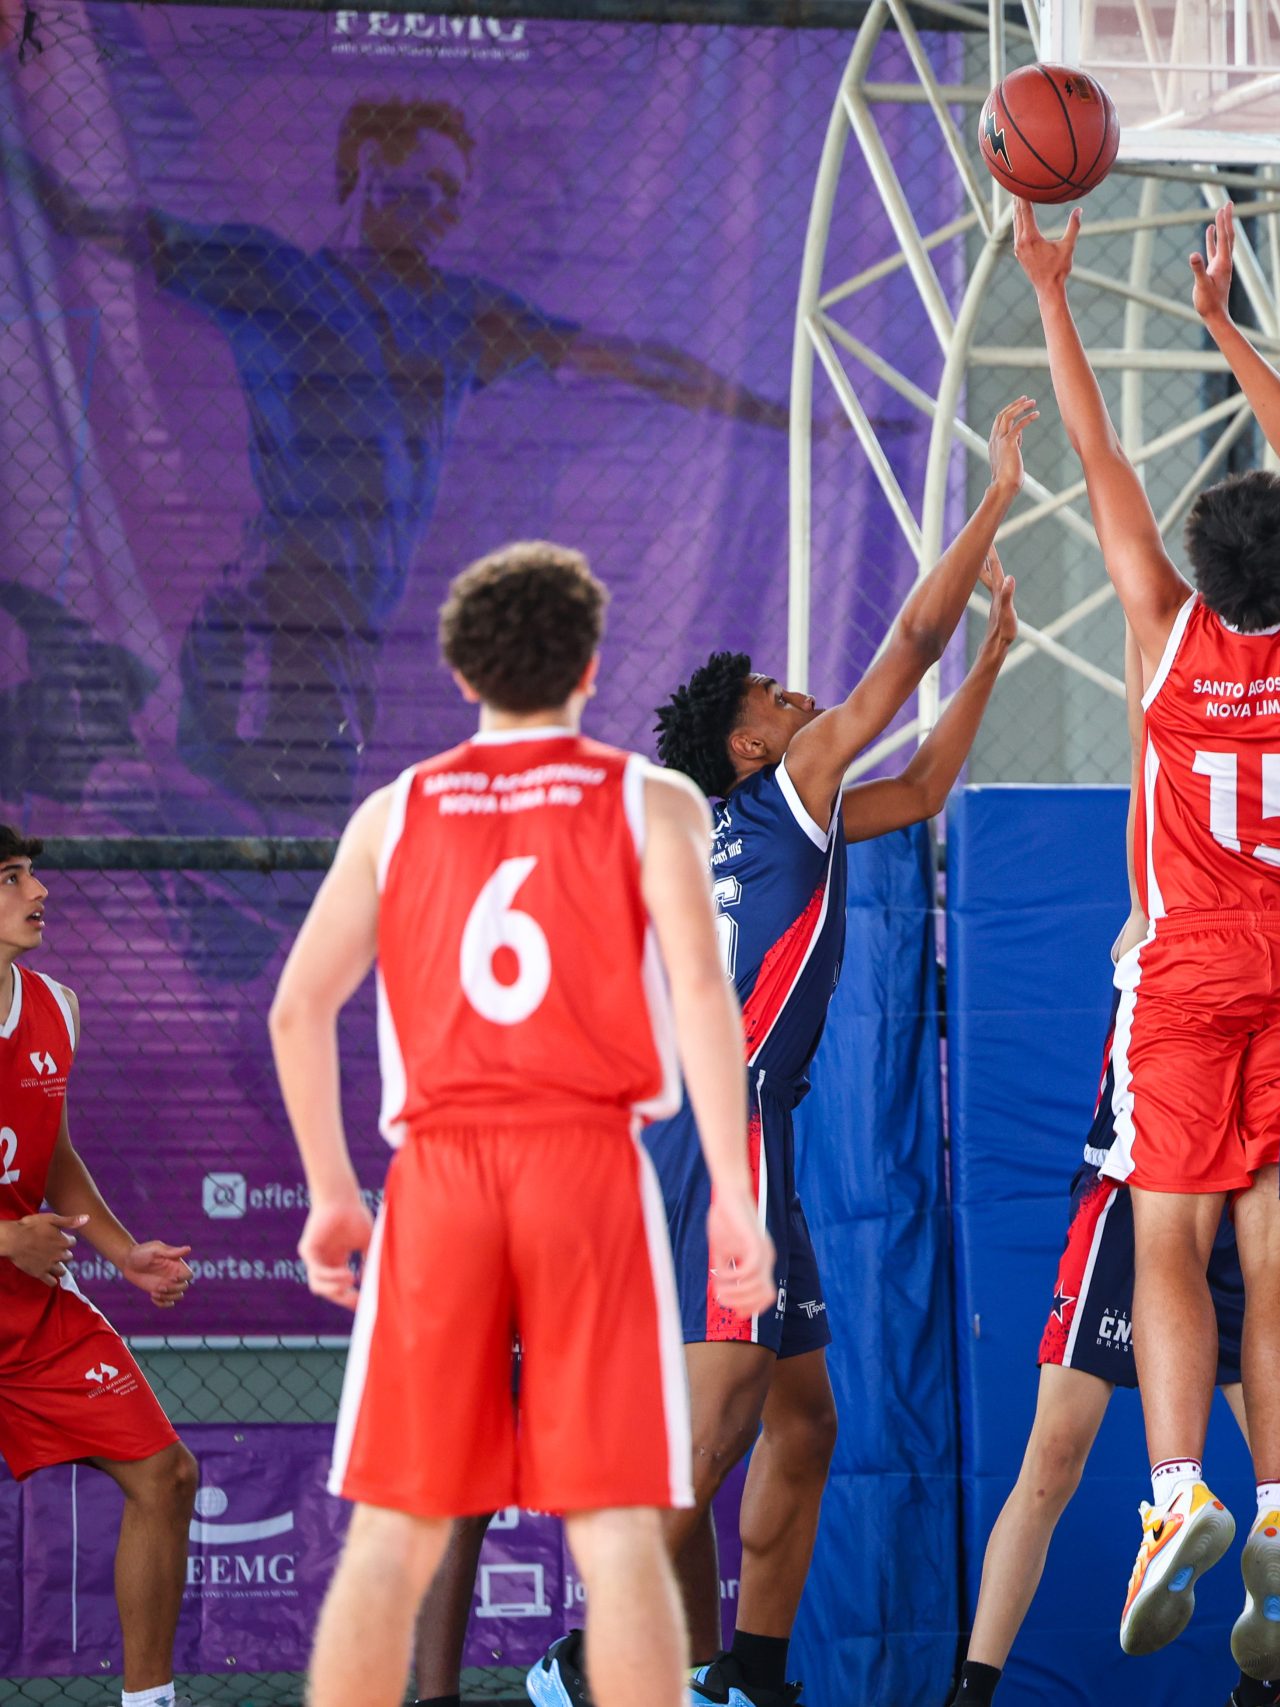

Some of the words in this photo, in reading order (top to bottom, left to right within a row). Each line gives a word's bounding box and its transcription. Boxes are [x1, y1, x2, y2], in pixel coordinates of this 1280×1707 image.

[1192, 678, 1245, 698] SANTO
[1206, 702, 1251, 717] NOVA
[460, 855, 552, 1026] 6
[1098, 1315, 1134, 1346] CN
[1096, 1337, 1129, 1352] BRAS
[186, 1554, 296, 1585] EEMG
